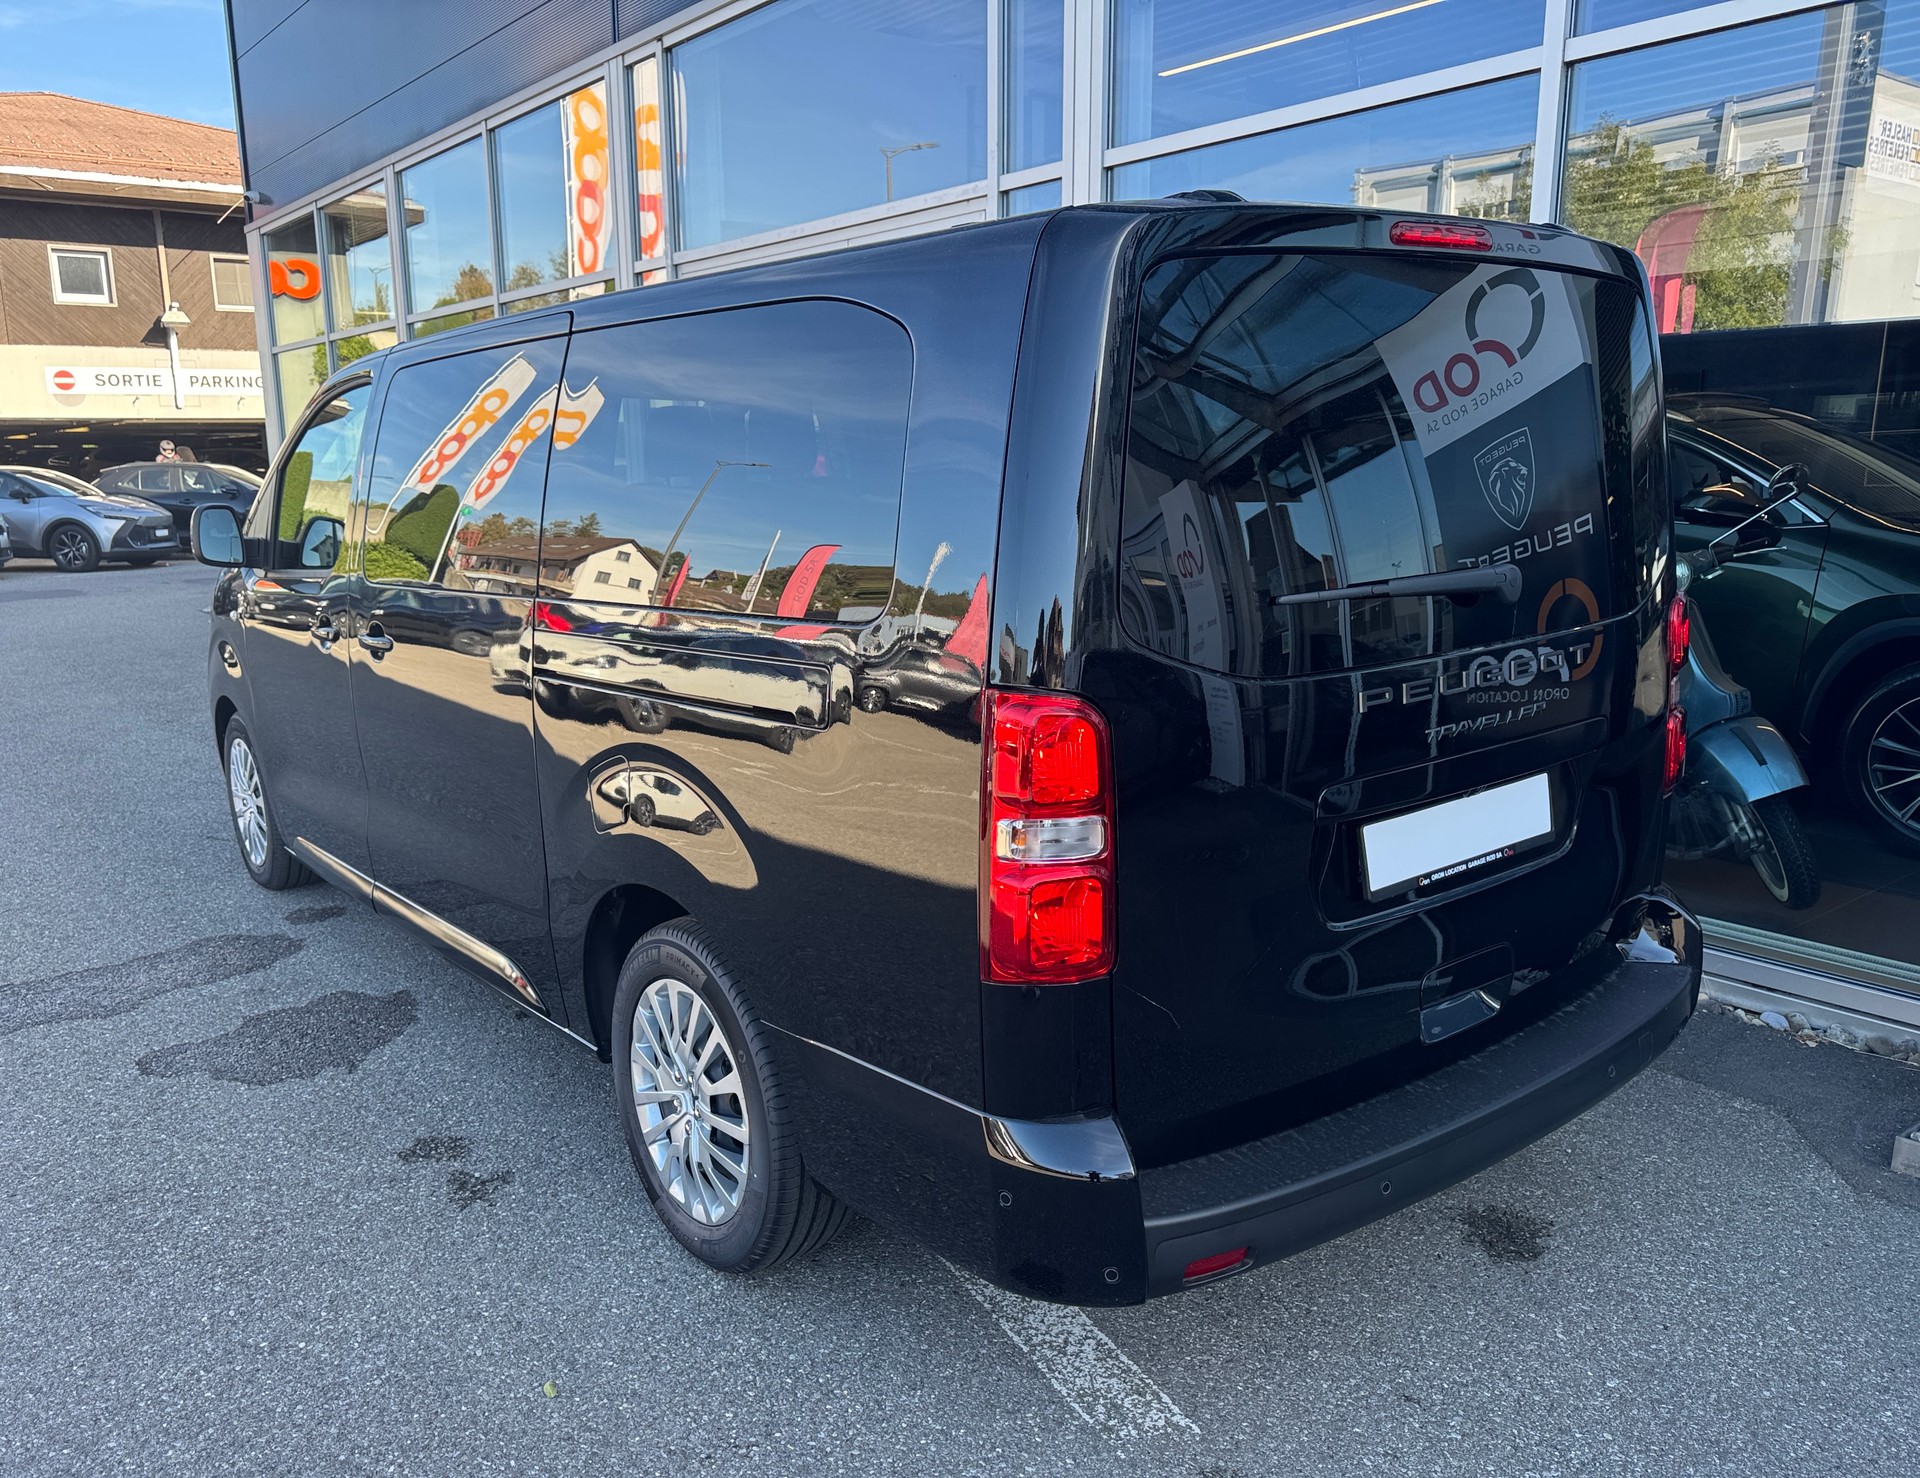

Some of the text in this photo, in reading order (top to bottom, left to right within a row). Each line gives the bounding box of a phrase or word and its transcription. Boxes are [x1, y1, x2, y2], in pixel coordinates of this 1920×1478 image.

[94, 373, 163, 388] SORTIE
[1358, 642, 1591, 714] PEUGEOT
[1425, 701, 1546, 743] TRAVELLER
[1445, 864, 1467, 876] LOCATION
[1468, 858, 1486, 868] GARAGE
[621, 948, 659, 992] MICHELIN
[665, 952, 695, 977] PRIMACY
